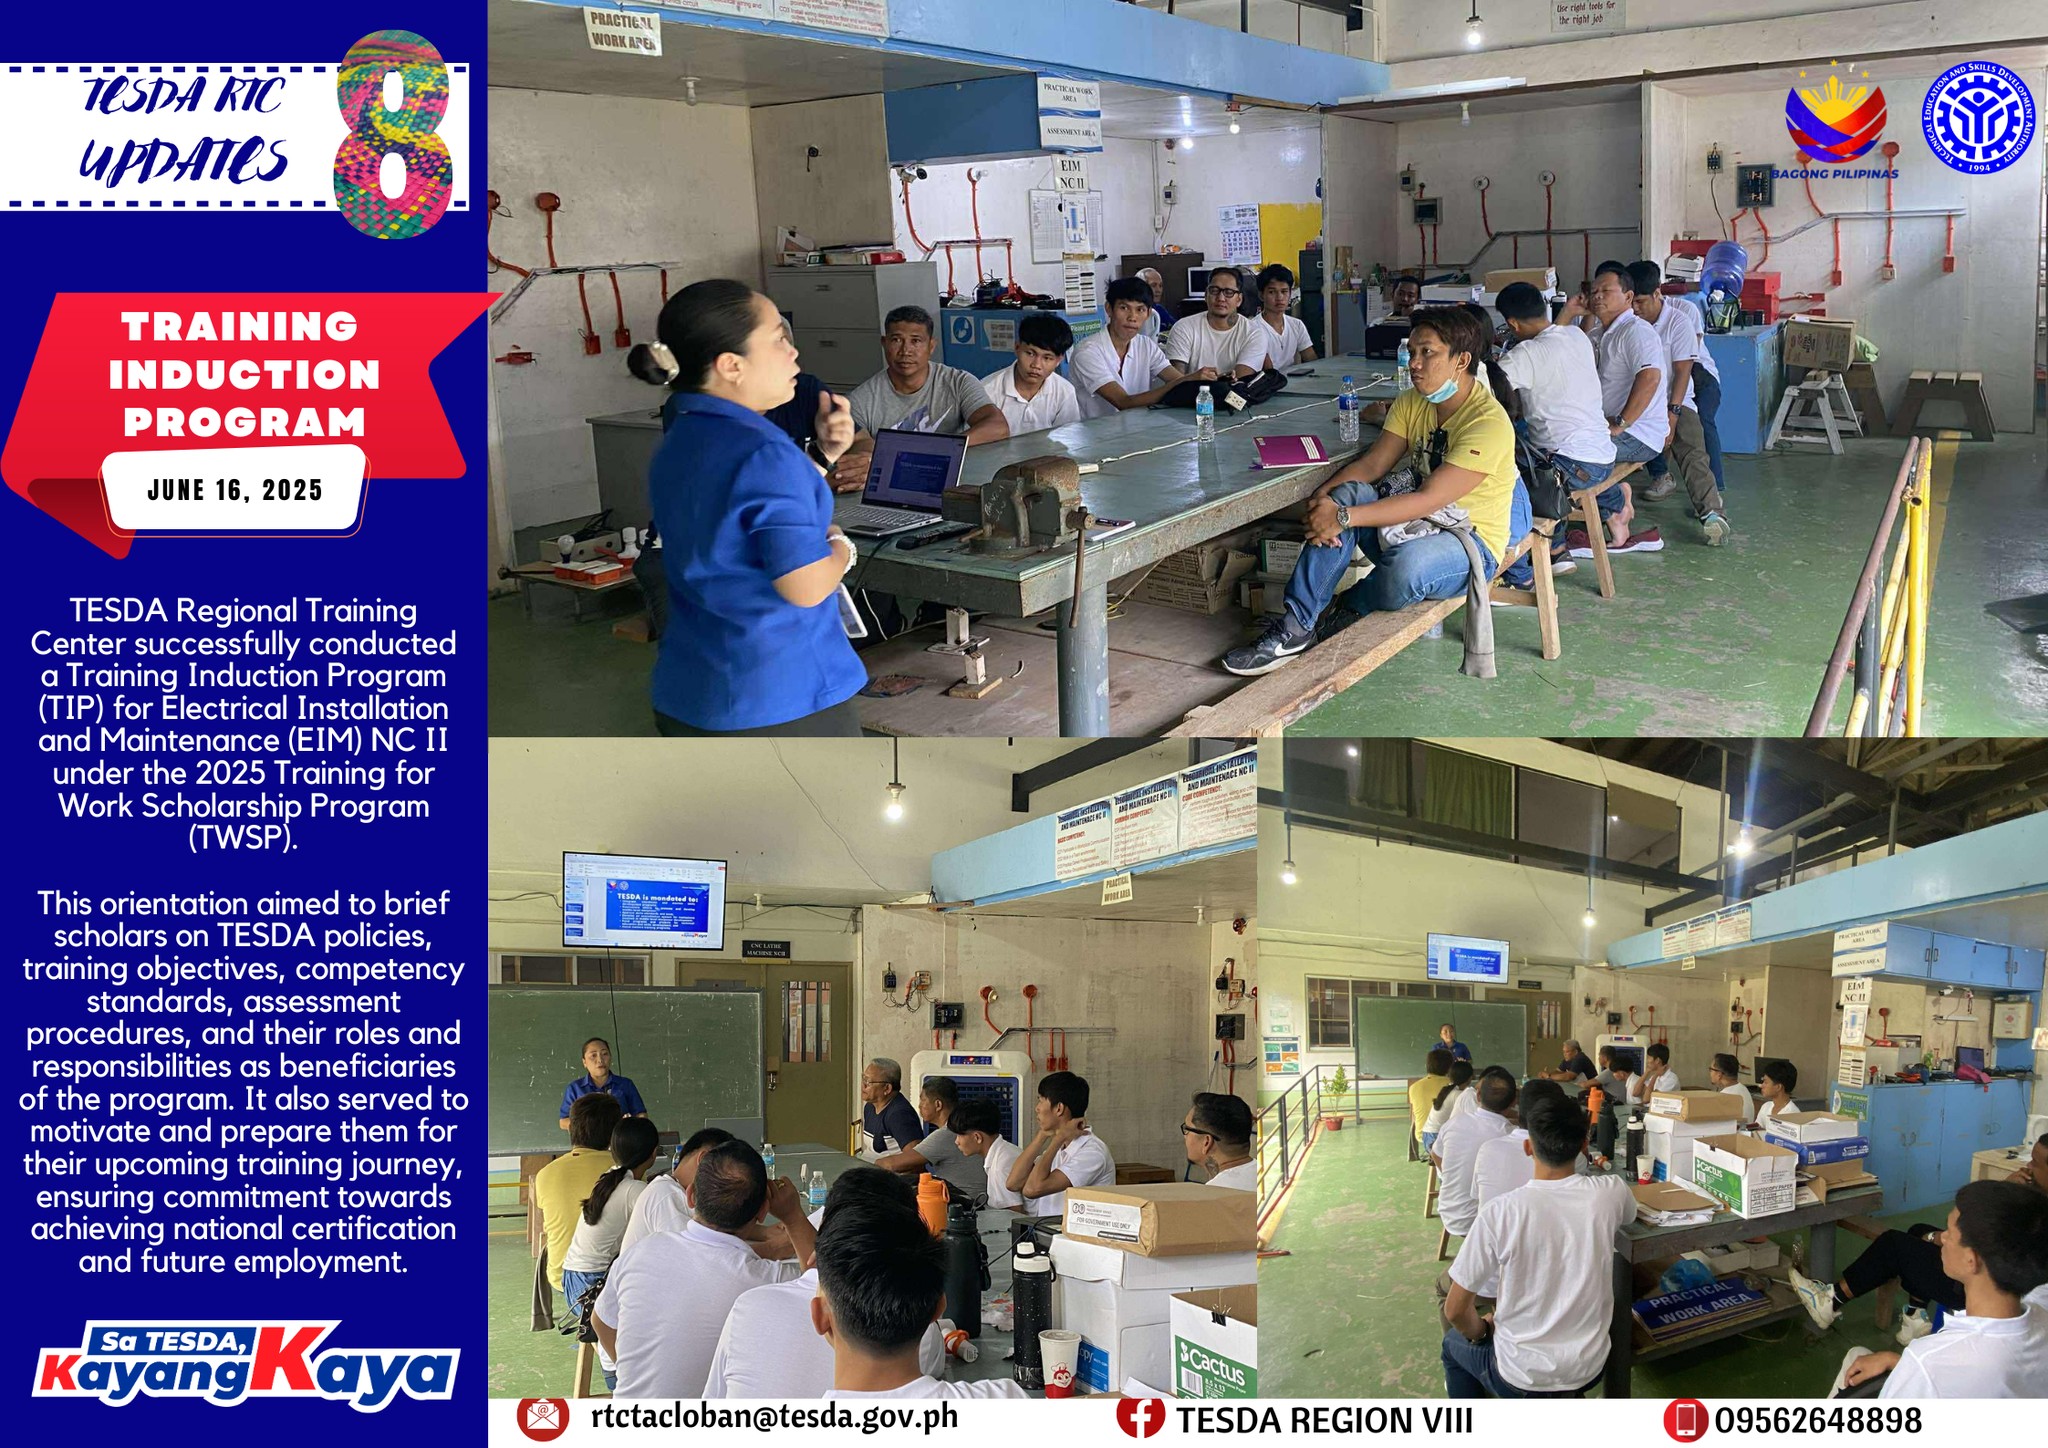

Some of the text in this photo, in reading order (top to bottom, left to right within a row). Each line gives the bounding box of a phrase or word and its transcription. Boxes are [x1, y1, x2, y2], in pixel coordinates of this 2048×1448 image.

[1557, 1, 1616, 13] Use right tools for
[590, 11, 653, 30] PRACTICAL
[1559, 13, 1604, 26] the right job
[591, 32, 656, 51] WORK AREA
[1043, 83, 1093, 95] PRACTICAL WORK
[1062, 95, 1077, 103] AREA
[1047, 127, 1096, 137] ASSESSMENT AREA
[1061, 160, 1081, 172] EIM
[1060, 177, 1085, 189] NC II
[1187, 780, 1199, 792] AND
[1238, 765, 1248, 776] NC
[617, 892, 641, 901] TESDA
[650, 895, 687, 903] mandated
[1838, 931, 1865, 940] PRACTICAL
[1847, 981, 1865, 991] EIM
[1845, 993, 1857, 1002] NC
[1700, 1160, 1723, 1178] Cactus
[1751, 1186, 1778, 1194] PHOTOCOPY
[1085, 1217, 1111, 1228] GOVERNMENT
[1649, 1281, 1734, 1309] PRACTICAL
[1659, 1292, 1753, 1324] WORK AREA
[1190, 1348, 1246, 1387] Cactus
